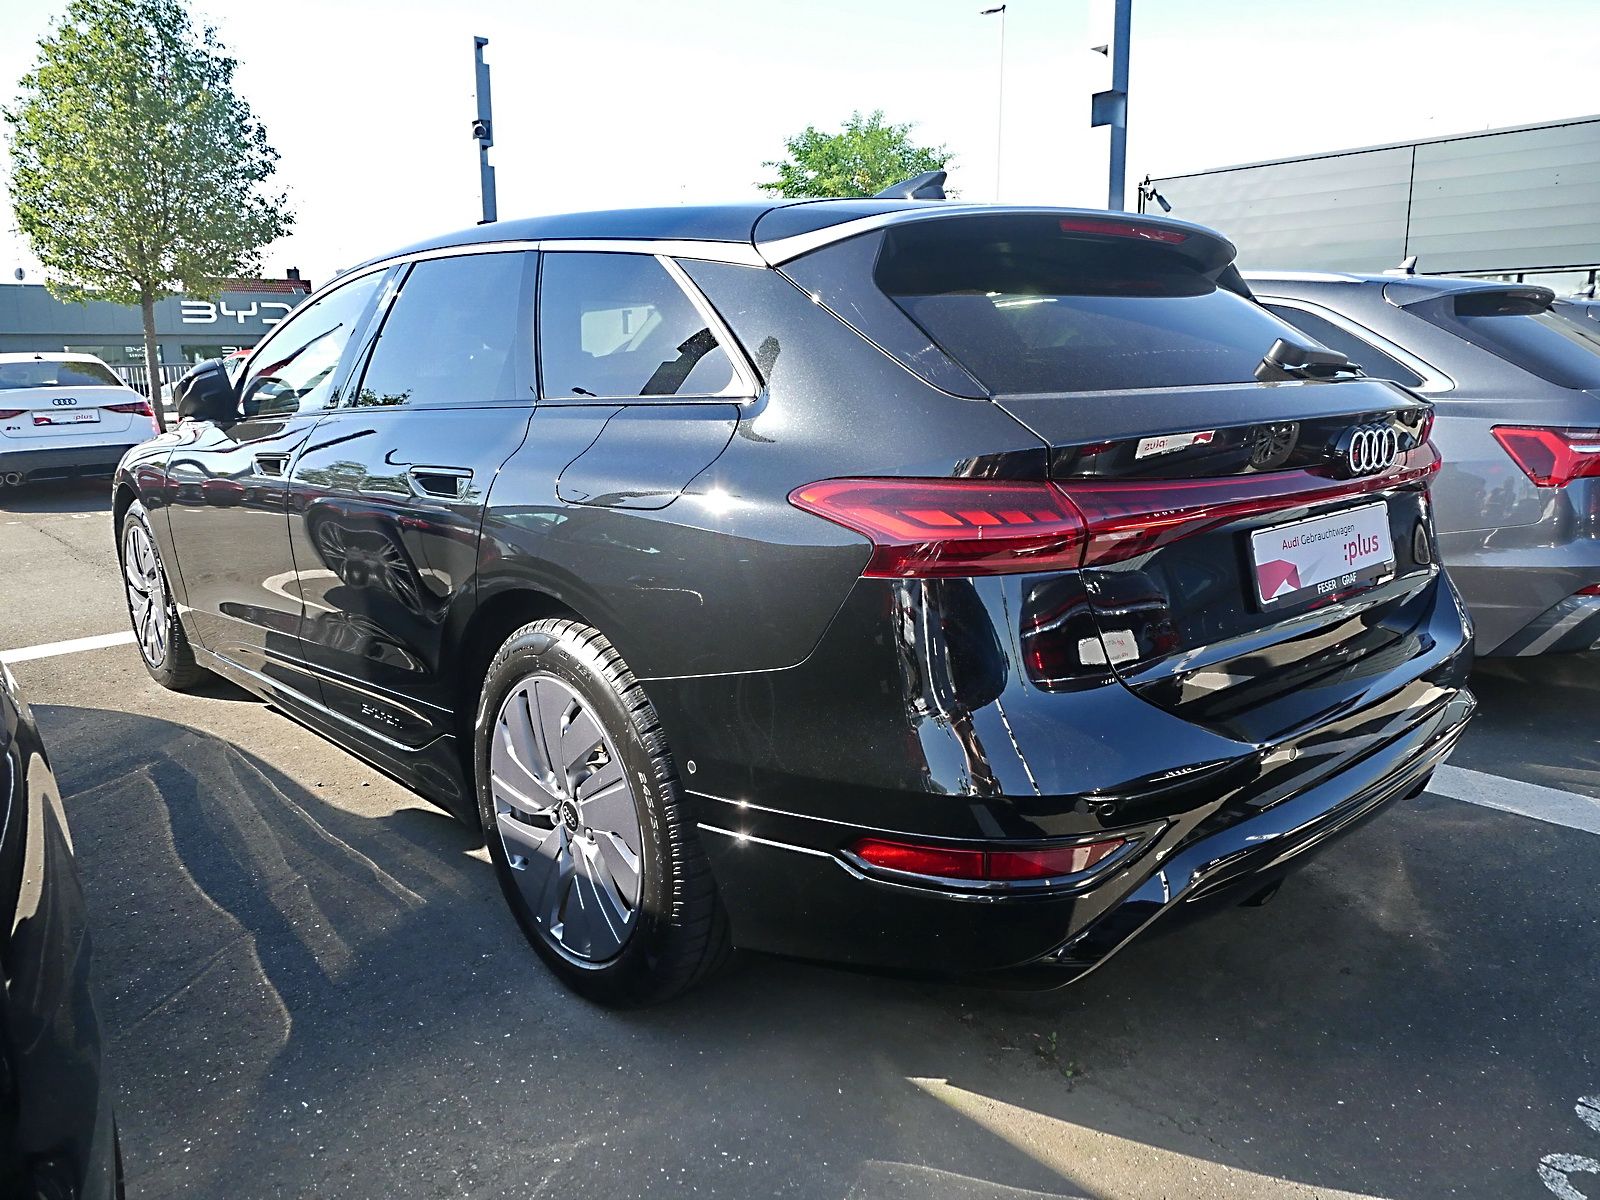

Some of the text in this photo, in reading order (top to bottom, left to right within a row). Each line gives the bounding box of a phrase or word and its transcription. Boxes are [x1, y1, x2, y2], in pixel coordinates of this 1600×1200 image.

[1282, 524, 1355, 550] Audi Gebrauchtwagen
[1317, 572, 1358, 595] FESER GRAF
